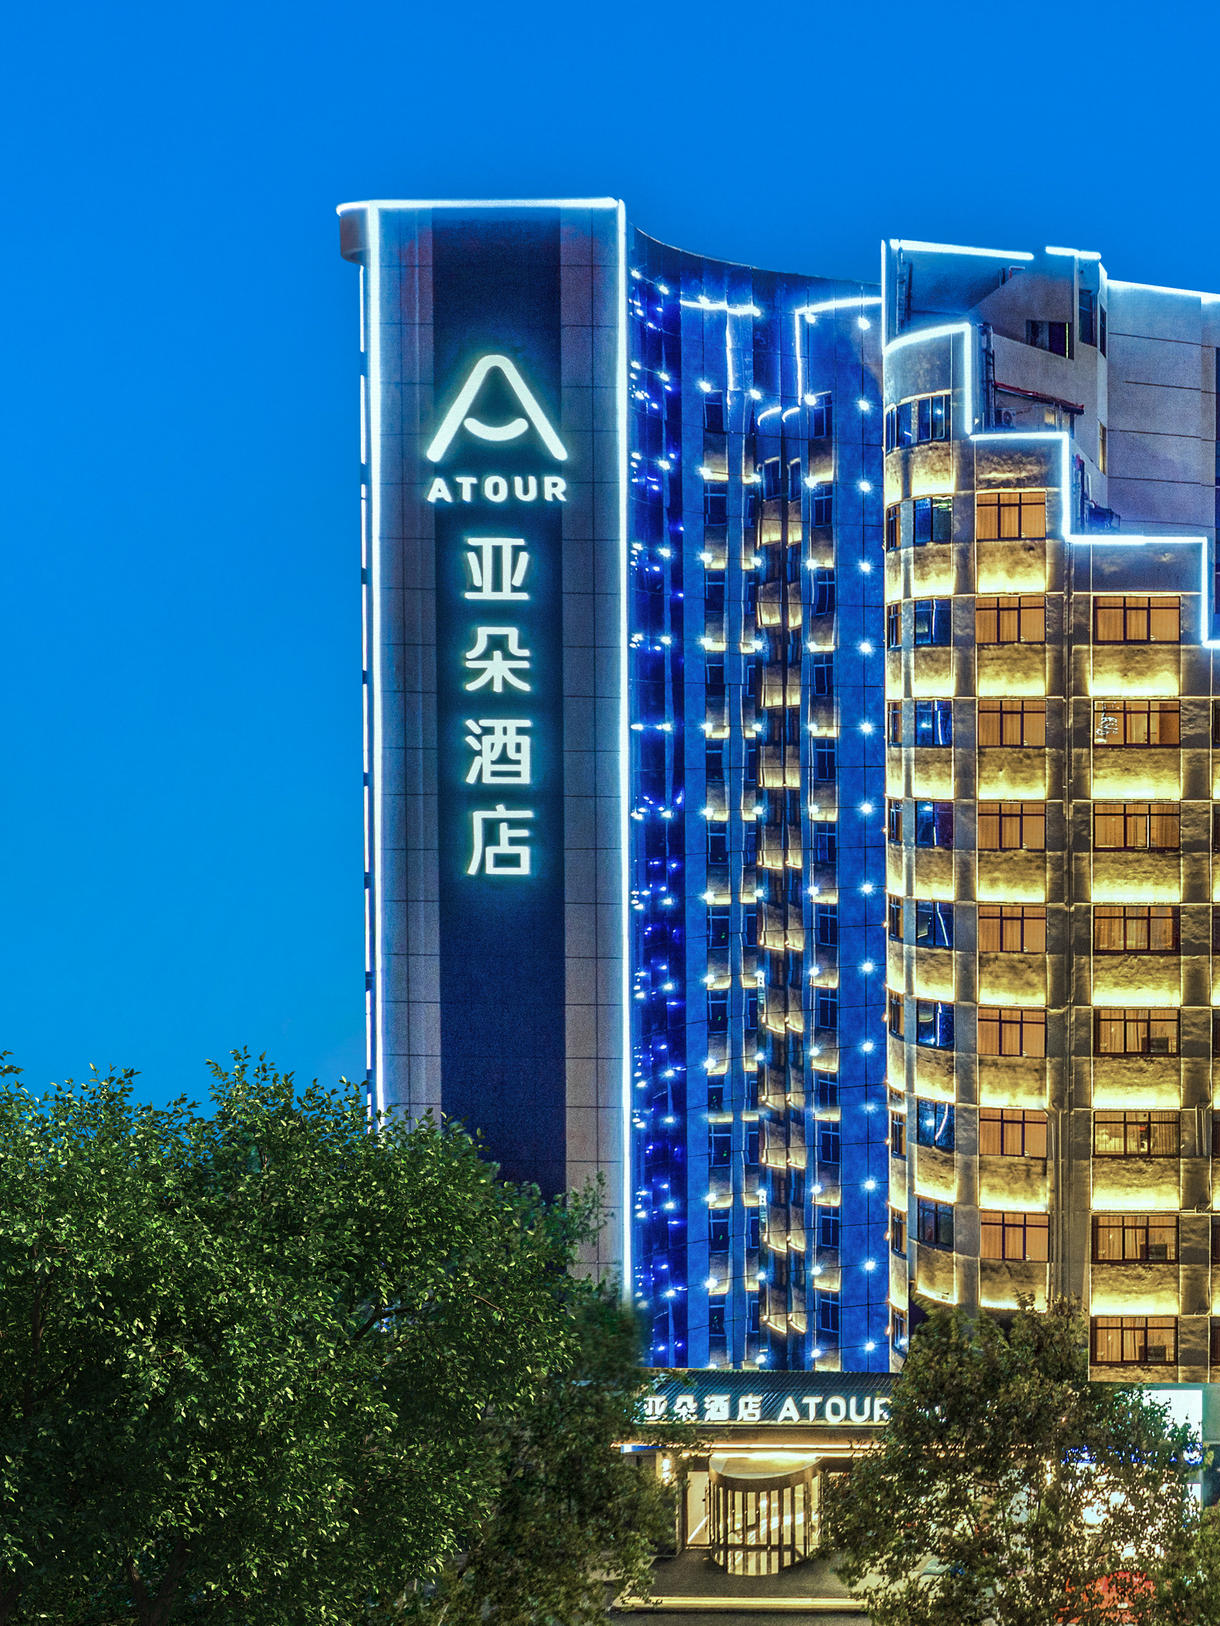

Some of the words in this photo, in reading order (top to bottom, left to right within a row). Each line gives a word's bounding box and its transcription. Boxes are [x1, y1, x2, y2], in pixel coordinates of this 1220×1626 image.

[427, 475, 567, 503] ATOUR
[464, 537, 534, 876] 亚朵酒店
[643, 1394, 762, 1423] 亚朵酒店
